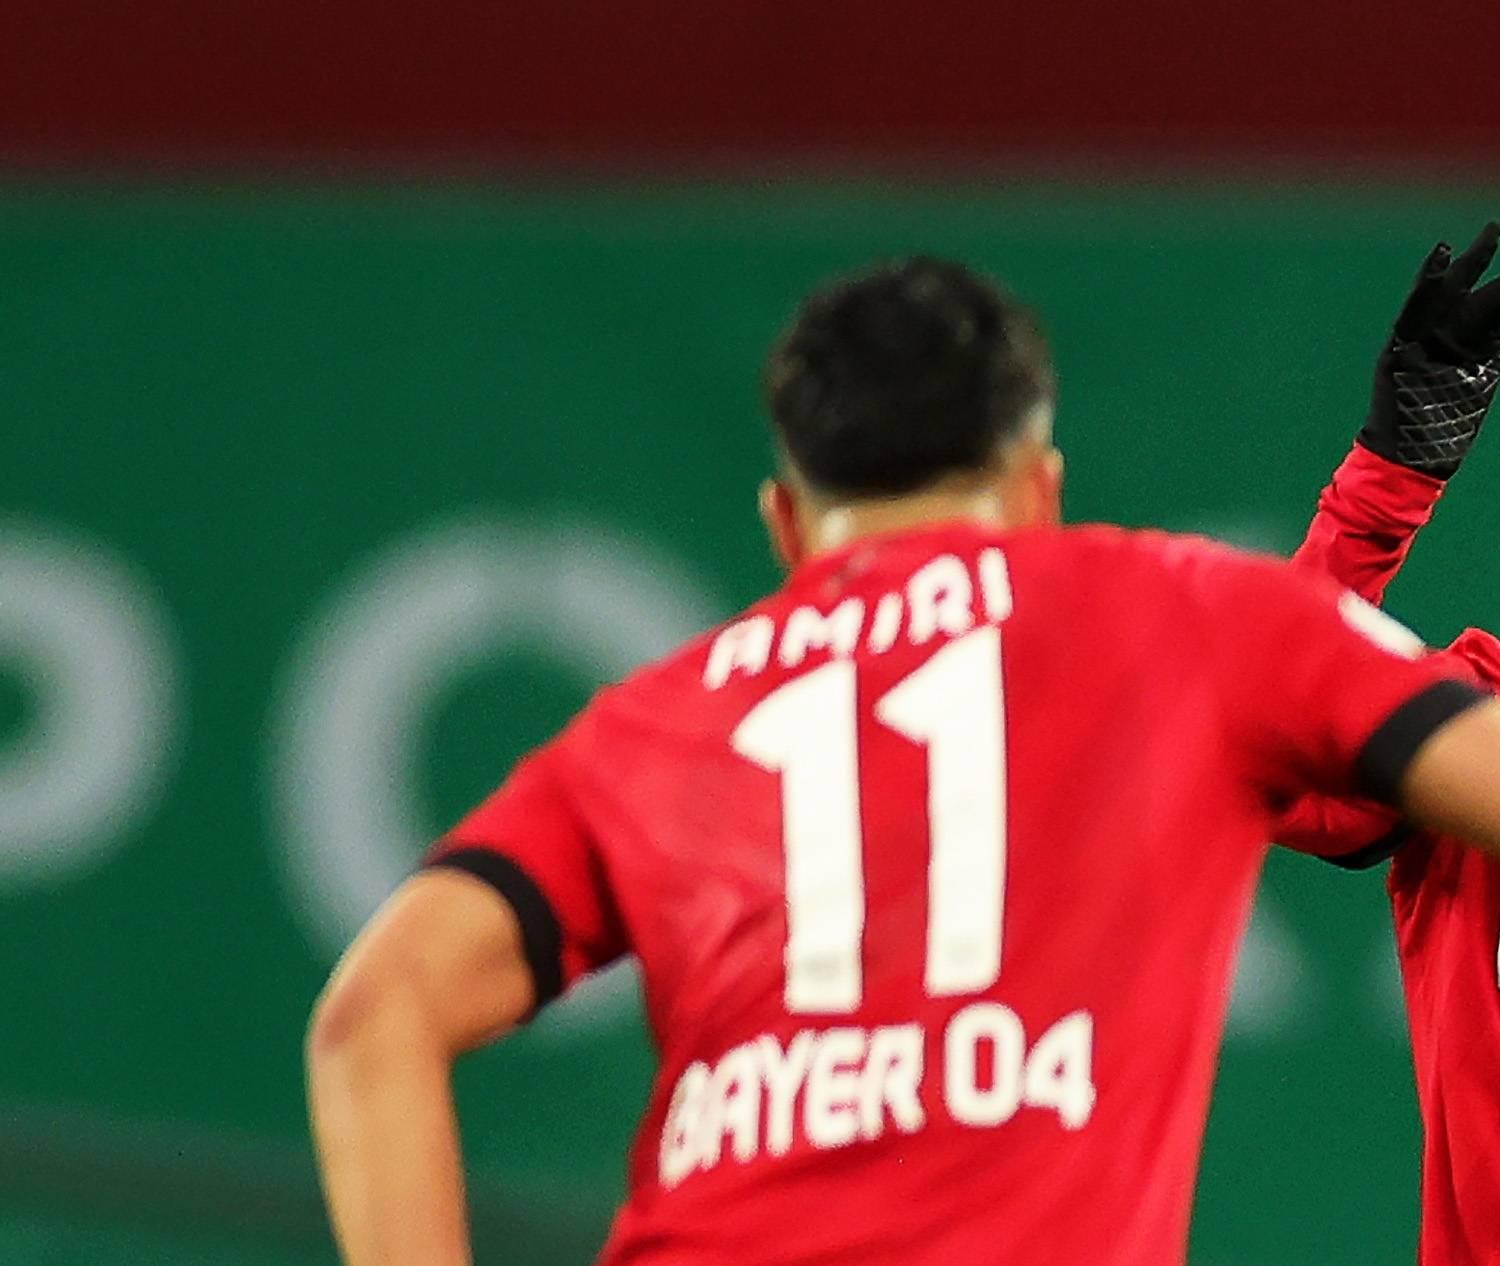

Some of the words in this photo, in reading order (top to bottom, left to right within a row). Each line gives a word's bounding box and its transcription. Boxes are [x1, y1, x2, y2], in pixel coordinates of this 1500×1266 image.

[702, 546, 1014, 690] AMIRI
[730, 624, 1007, 1014] 11
[658, 1022, 928, 1190] BAYER
[943, 1002, 1097, 1131] 04
